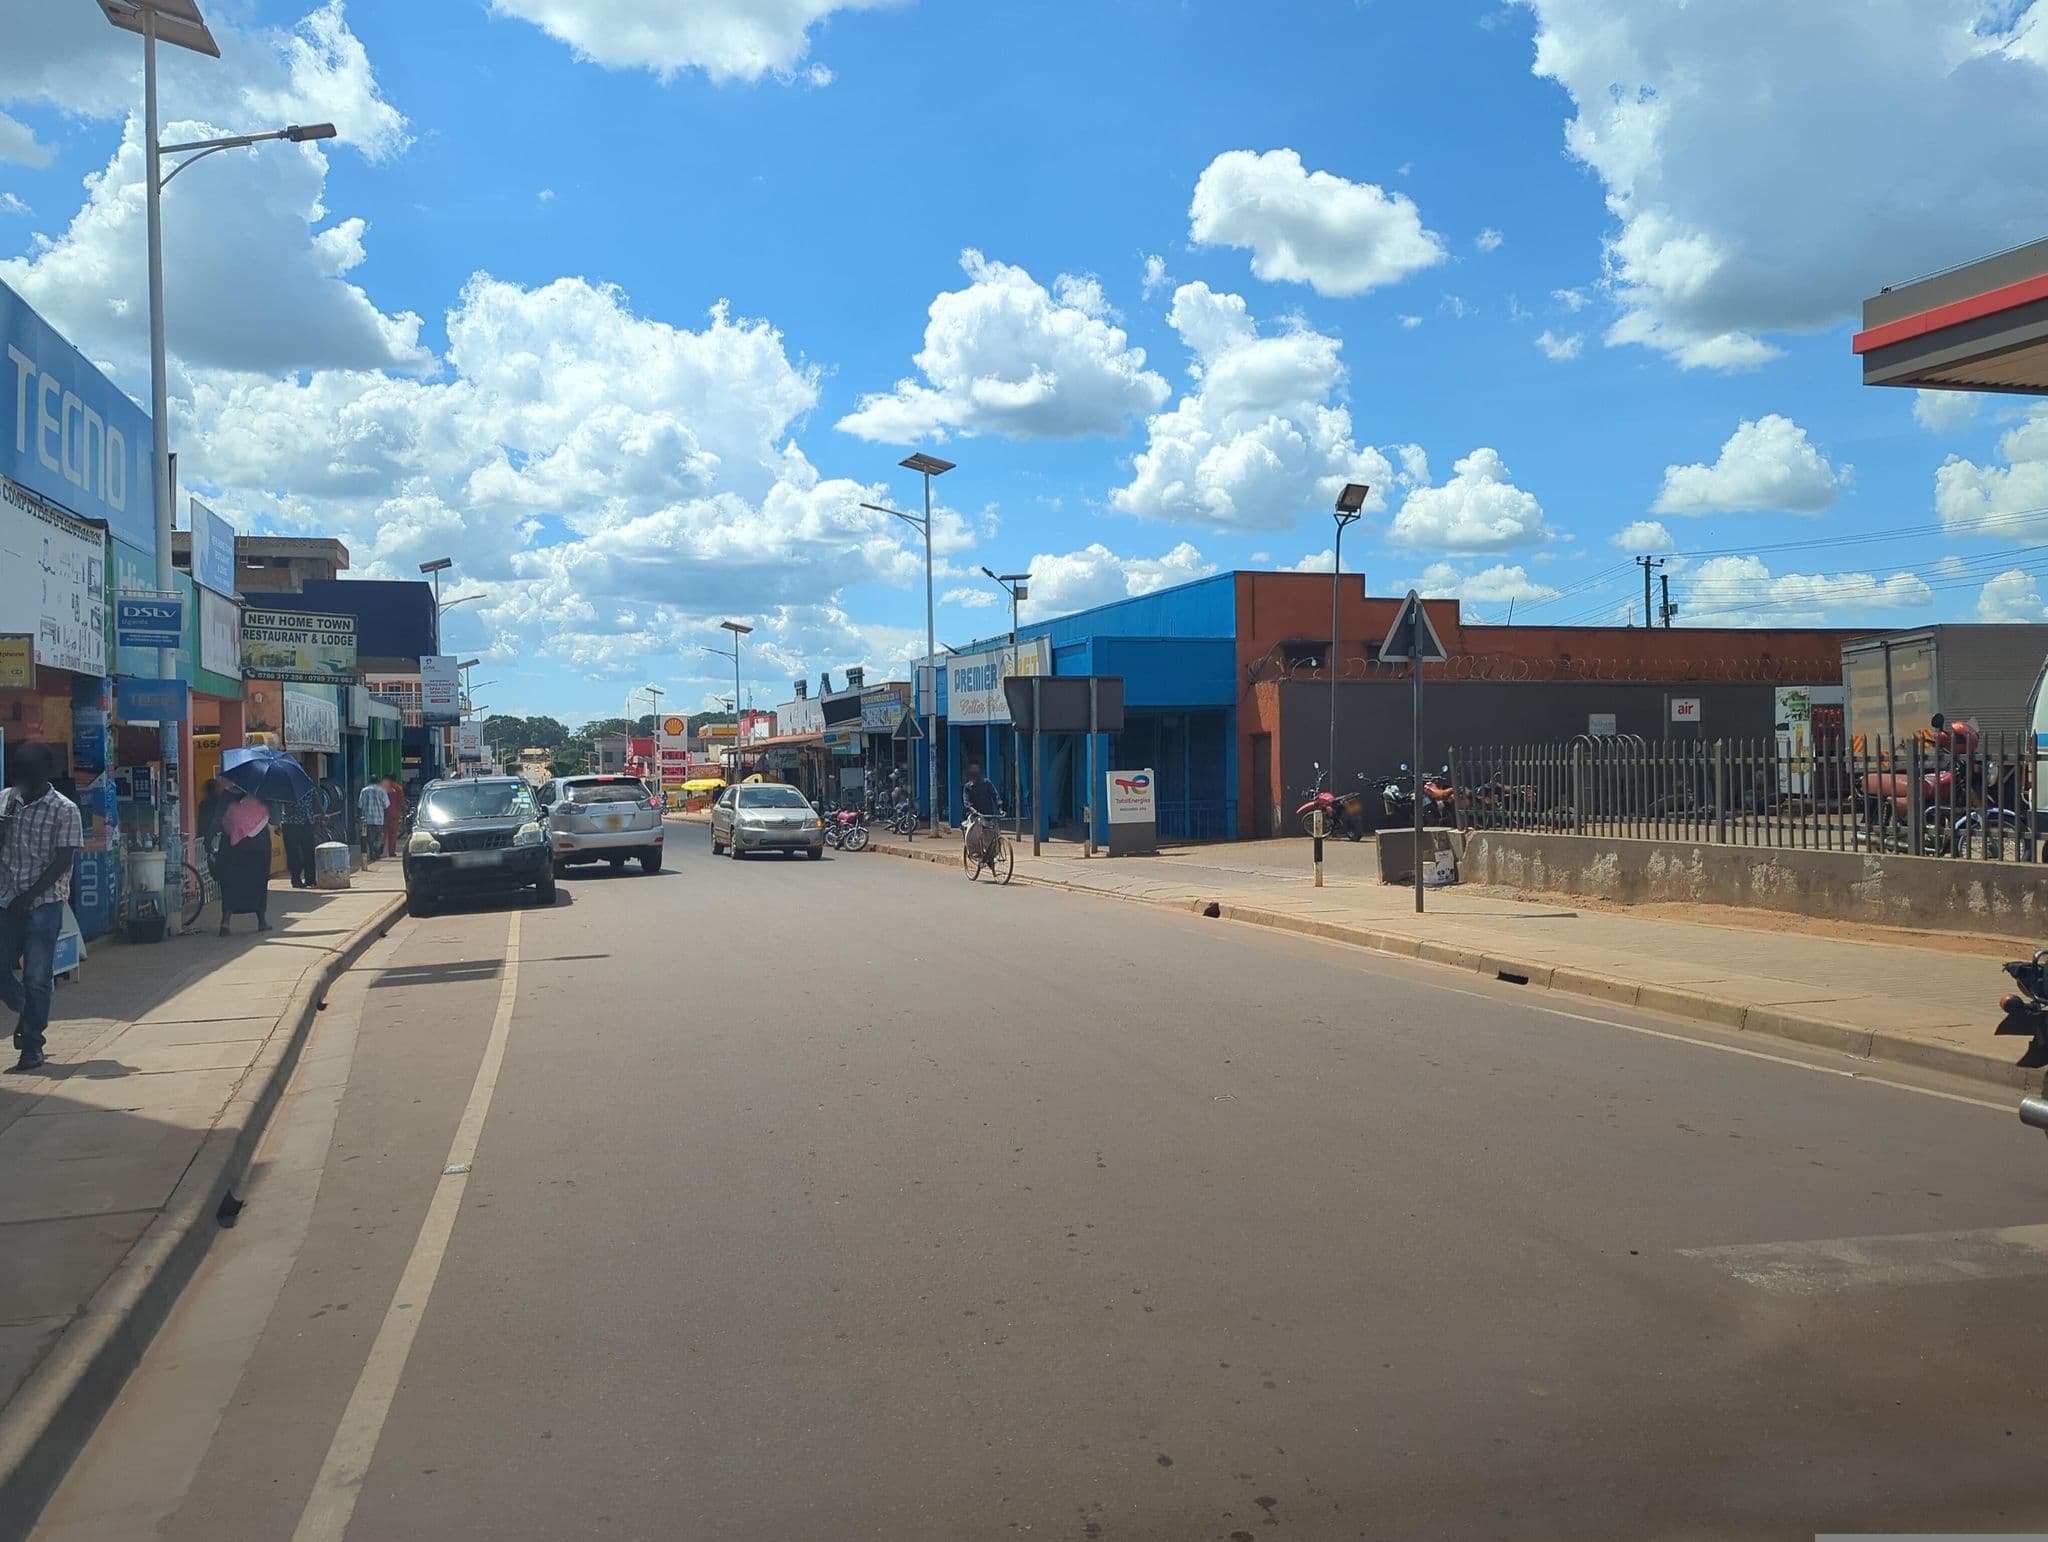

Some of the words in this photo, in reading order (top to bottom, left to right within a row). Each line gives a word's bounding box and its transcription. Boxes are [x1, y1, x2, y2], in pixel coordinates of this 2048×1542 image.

[8, 343, 126, 512] TECNO
[123, 606, 176, 618] DStv
[247, 613, 276, 626] NEW
[279, 615, 313, 628] HOME
[316, 618, 351, 631] TOWN
[242, 628, 308, 644] RESTAURANT
[311, 633, 318, 645] &
[321, 634, 354, 646] LODGE
[954, 662, 998, 693] PREMIER
[1677, 701, 1694, 715] air
